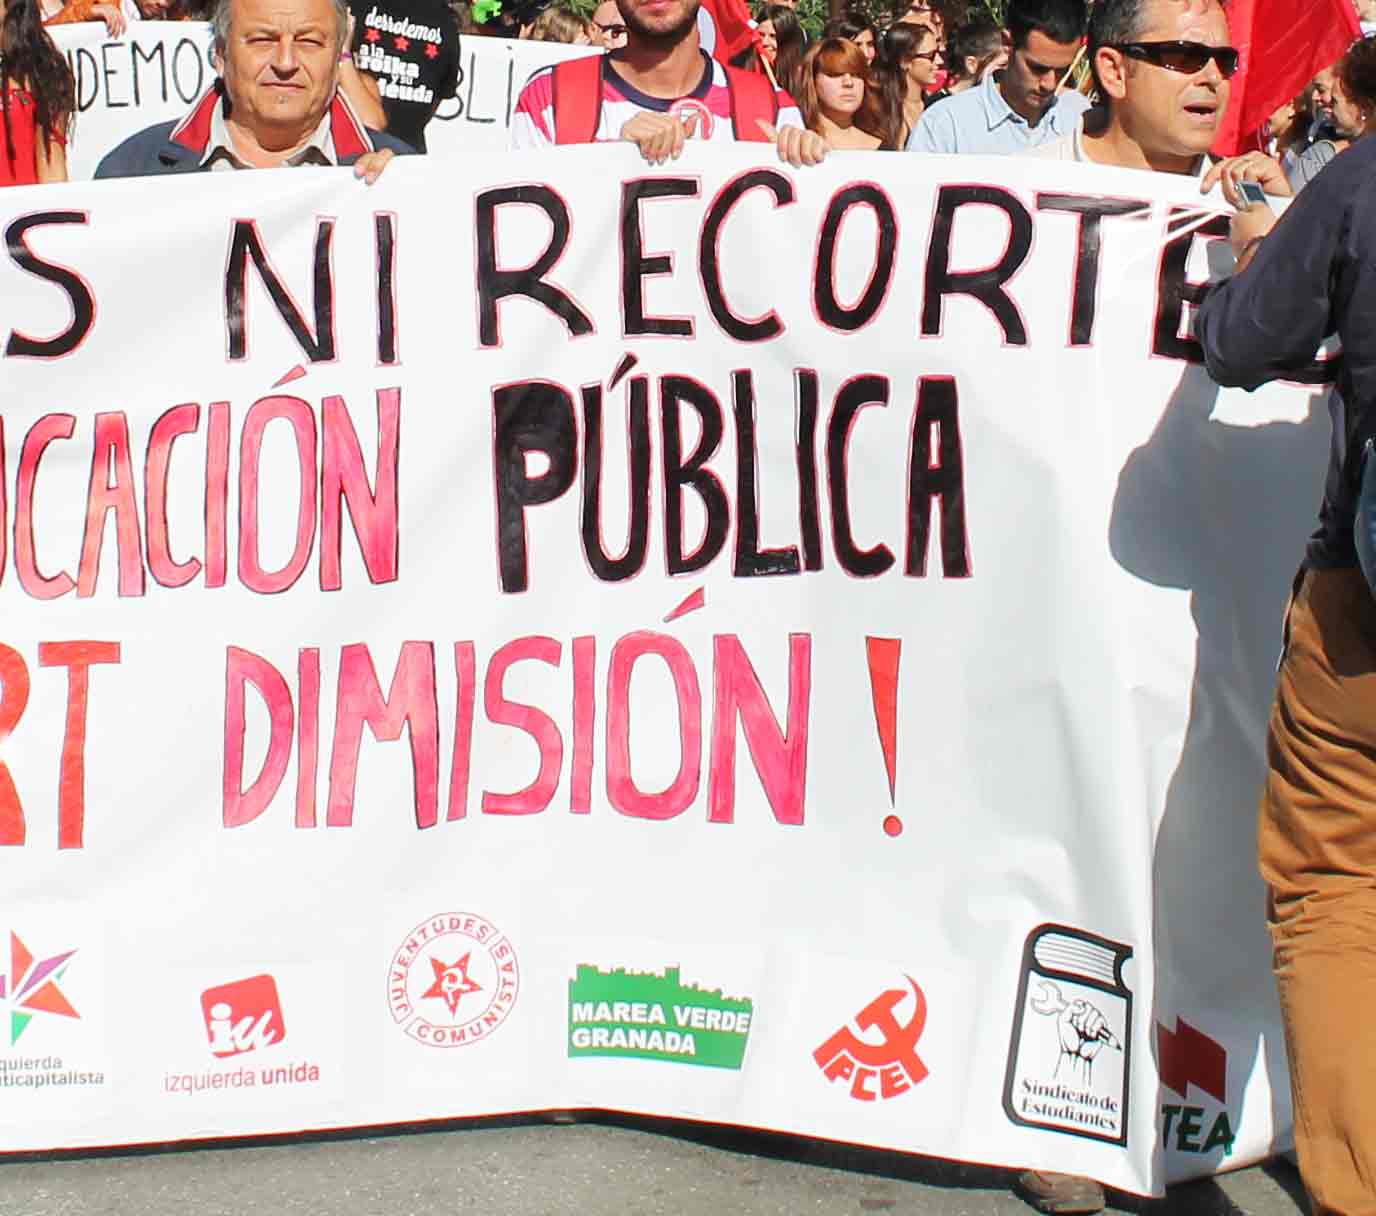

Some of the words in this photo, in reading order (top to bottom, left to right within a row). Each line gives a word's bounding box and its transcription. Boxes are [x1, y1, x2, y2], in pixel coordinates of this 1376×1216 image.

[365, 6, 442, 44] derrotemos
[68, 37, 216, 112] DEMO
[224, 208, 403, 365] NI
[472, 167, 1342, 390] RECORTE
[492, 351, 972, 594] PÚBLICA
[392, 917, 489, 1012] JUVENTUDES
[572, 1002, 666, 1025] MAREA
[673, 1005, 751, 1034] VERDE
[572, 1027, 696, 1056] GRANADA
[164, 1068, 255, 1096] izquierda
[262, 1062, 320, 1085] unida
[1022, 1079, 1098, 1110] Sindicato
[1021, 1098, 1118, 1131] Estudiantes
